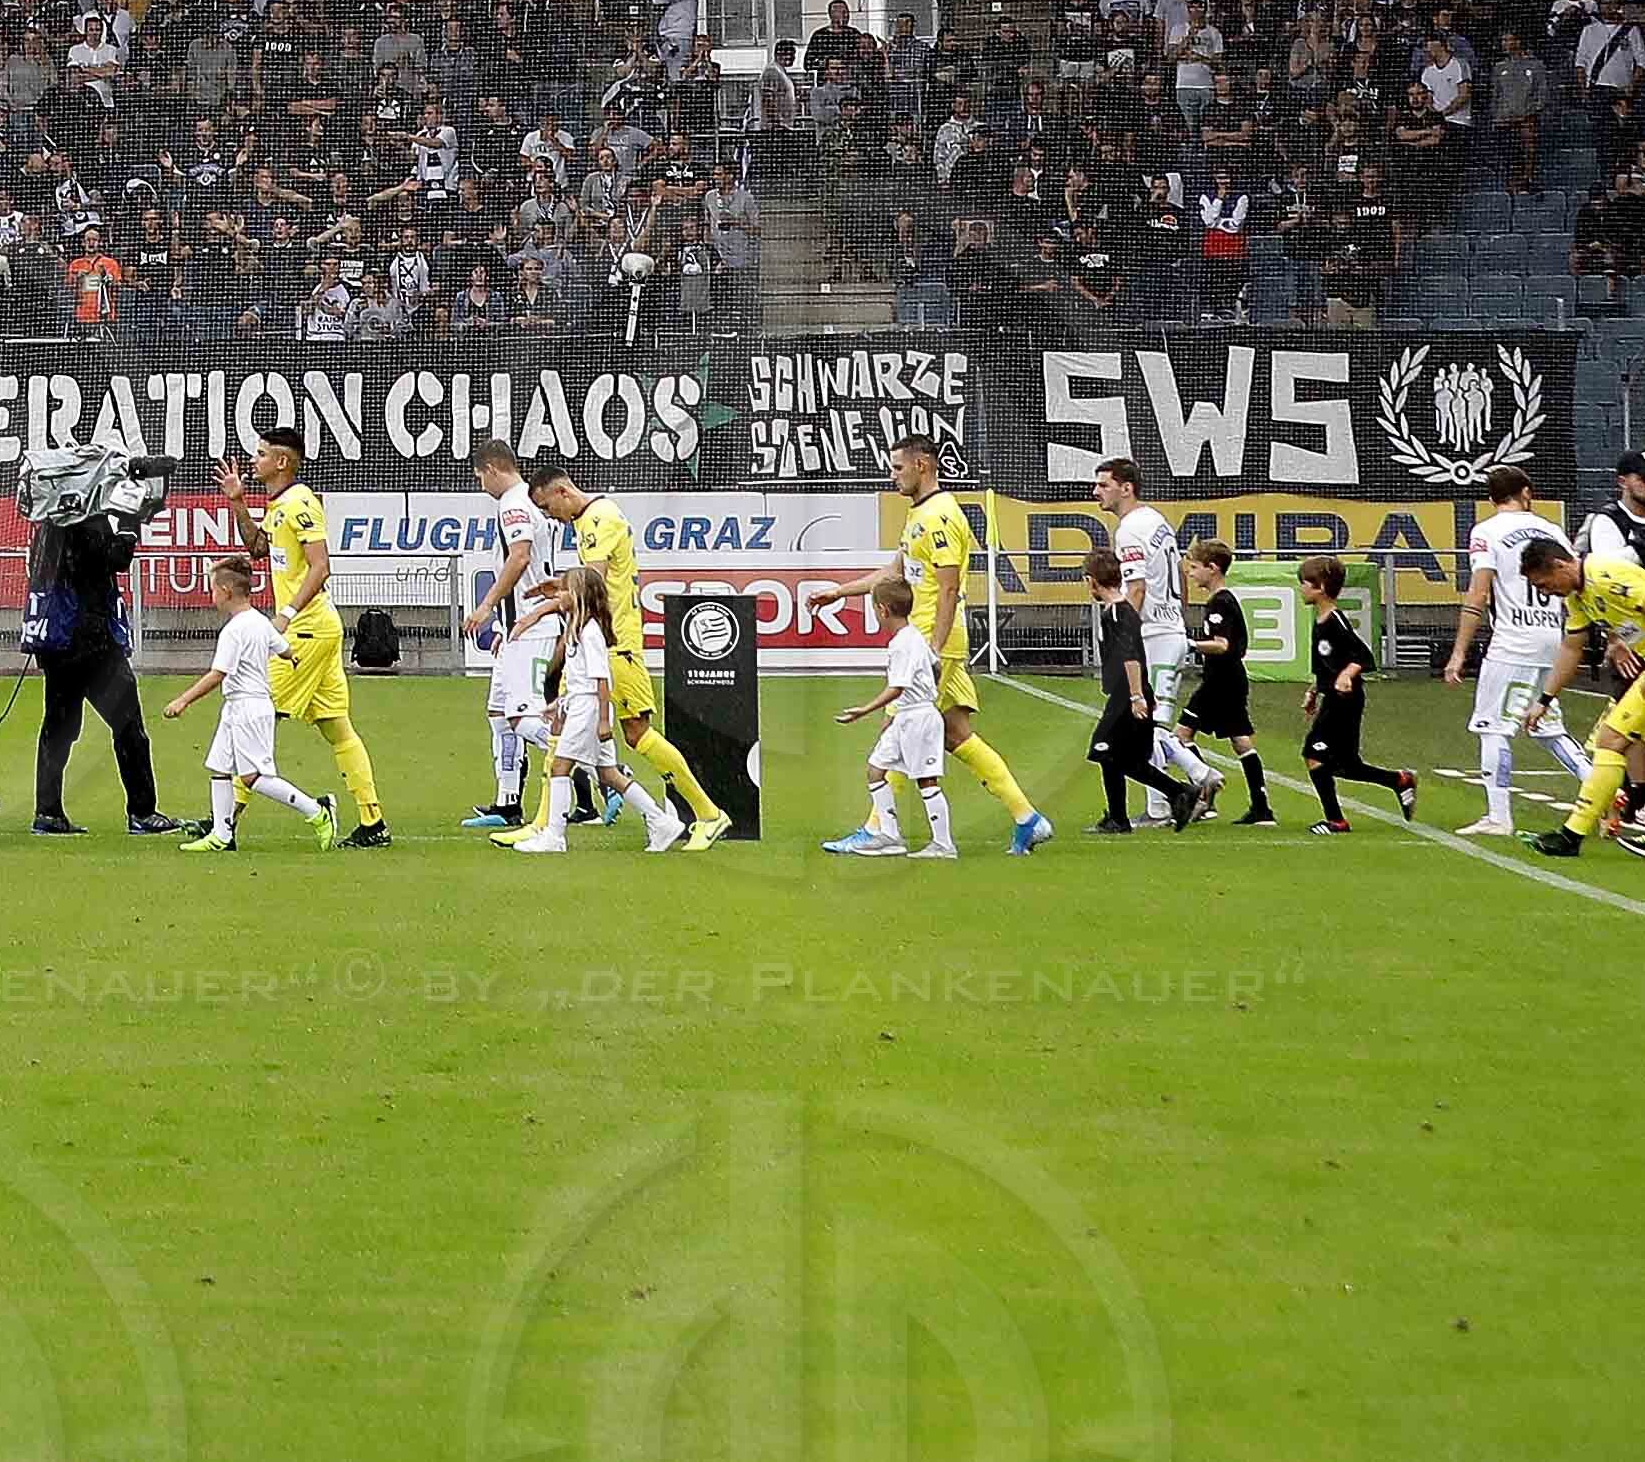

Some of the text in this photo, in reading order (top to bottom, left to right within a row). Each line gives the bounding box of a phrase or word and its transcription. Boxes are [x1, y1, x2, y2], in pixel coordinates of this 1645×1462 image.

[386, 368, 704, 463] CHAOS
[747, 350, 968, 414] SCHWARZE
[1043, 344, 1359, 485] SWS
[750, 407, 865, 477] SZENE
[643, 516, 778, 552] GRAZ
